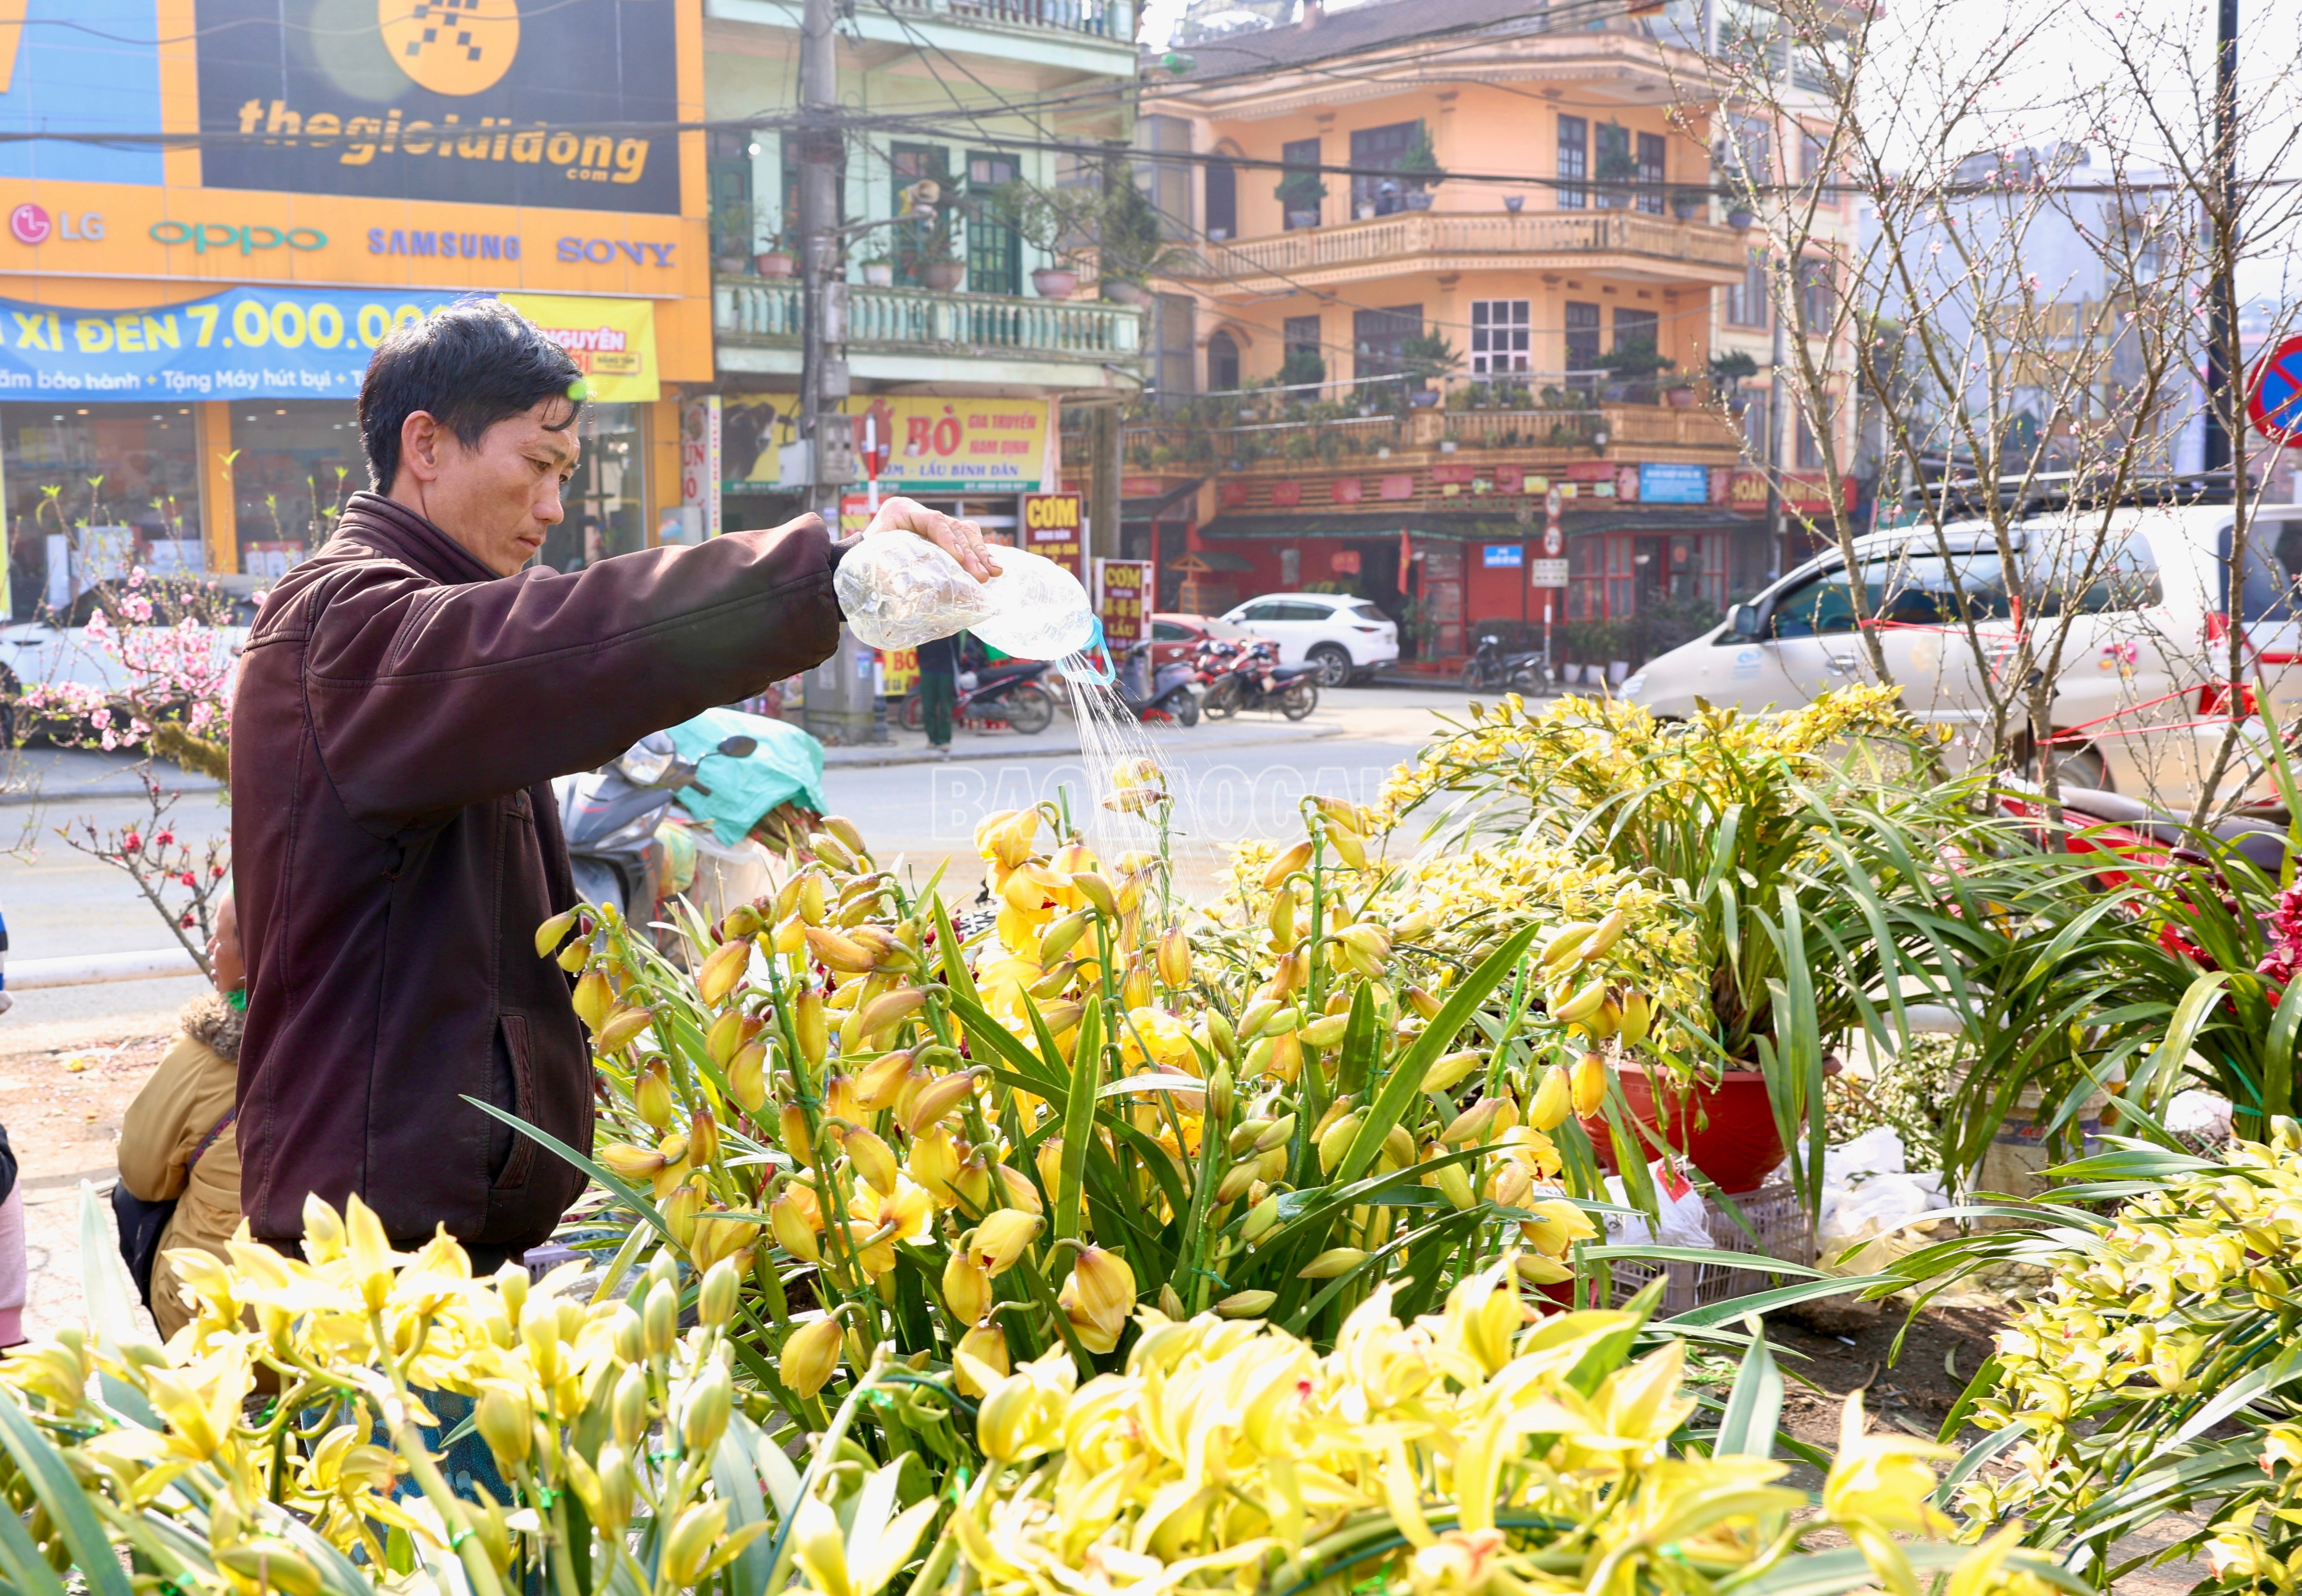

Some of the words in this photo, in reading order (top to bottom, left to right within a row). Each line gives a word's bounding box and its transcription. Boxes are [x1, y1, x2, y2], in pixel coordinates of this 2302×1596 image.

[60, 211, 105, 240] LG
[367, 227, 521, 260] SAMSUNG
[556, 236, 677, 267] SONY
[0, 368, 32, 389] ăm
[37, 369, 81, 390] bảo
[85, 371, 141, 391] hành
[161, 369, 211, 394] Tặng
[216, 368, 257, 389] Máy
[263, 368, 298, 387] hút
[300, 369, 332, 392] bụi
[902, 403, 963, 457] BÒ
[1027, 495, 1079, 529] CƠM
[1105, 565, 1142, 589] CƠM
